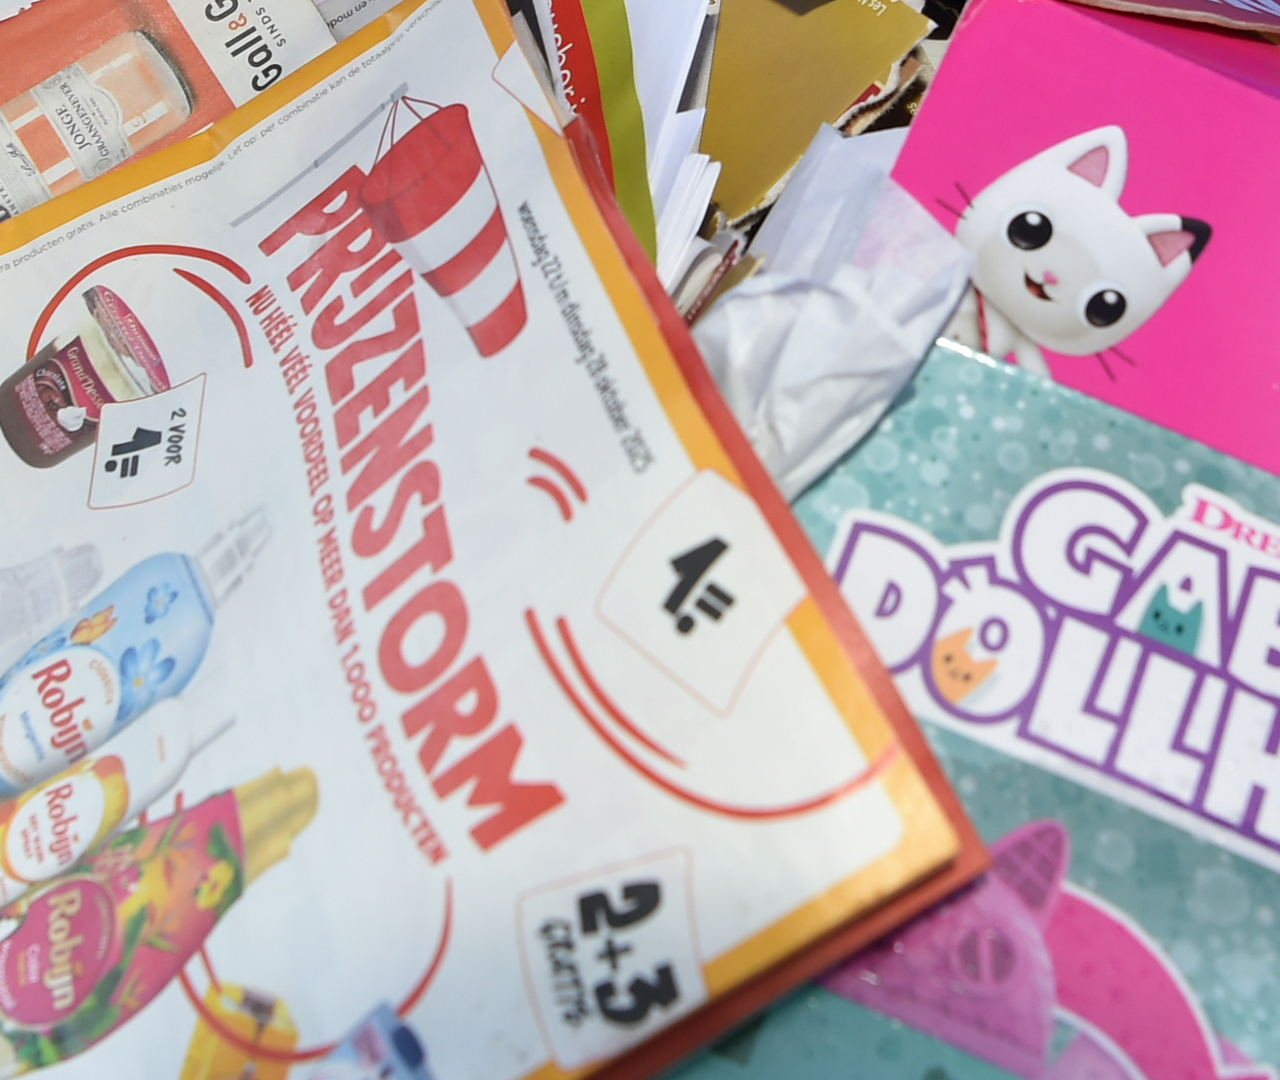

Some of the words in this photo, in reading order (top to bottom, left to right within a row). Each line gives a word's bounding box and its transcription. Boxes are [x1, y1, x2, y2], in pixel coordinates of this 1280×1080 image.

[228, 13, 247, 31] &
[254, 6, 286, 47] SINDS
[353, 0, 368, 12] en
[869, 0, 887, 16] Les
[224, 29, 283, 92] Gall
[12, 238, 66, 267] producten
[67, 219, 97, 242] gratis.
[99, 208, 119, 223] Alle
[120, 180, 183, 214] combinaties
[184, 162, 227, 188] mogelijk.
[227, 147, 243, 162] Let
[243, 133, 260, 152] op:
[260, 124, 277, 141] per
[277, 90, 328, 129] combinatie
[328, 77, 346, 92] kan
[348, 65, 360, 80] de
[360, 32, 404, 71] totaalprijs
[55, 104, 88, 151] JONGE
[59, 81, 110, 159] GRAANGENEVER
[245, 284, 277, 316] NU
[67, 346, 87, 384] Grand
[517, 200, 551, 268] woensdag
[541, 255, 562, 278] 22
[561, 301, 595, 364] dinsdag
[595, 378, 631, 434] oktober
[621, 427, 656, 475] 2025
[36, 369, 66, 390] Chocolate
[164, 424, 186, 466] VOOR
[171, 408, 186, 420] 2
[293, 386, 330, 497] VOORDEEL
[258, 165, 567, 854] PRIJZENSTORM
[313, 494, 337, 526] OP
[316, 526, 345, 593] MEER
[327, 589, 356, 645] DAN
[32, 658, 90, 770] Robijn
[340, 644, 378, 724] 1.000
[46, 782, 75, 867] Robijn
[365, 723, 449, 867] PRODUCTEN
[45, 886, 82, 1011] Robijn
[538, 916, 585, 1030] GRATIS
[578, 878, 679, 1026] 2+3
